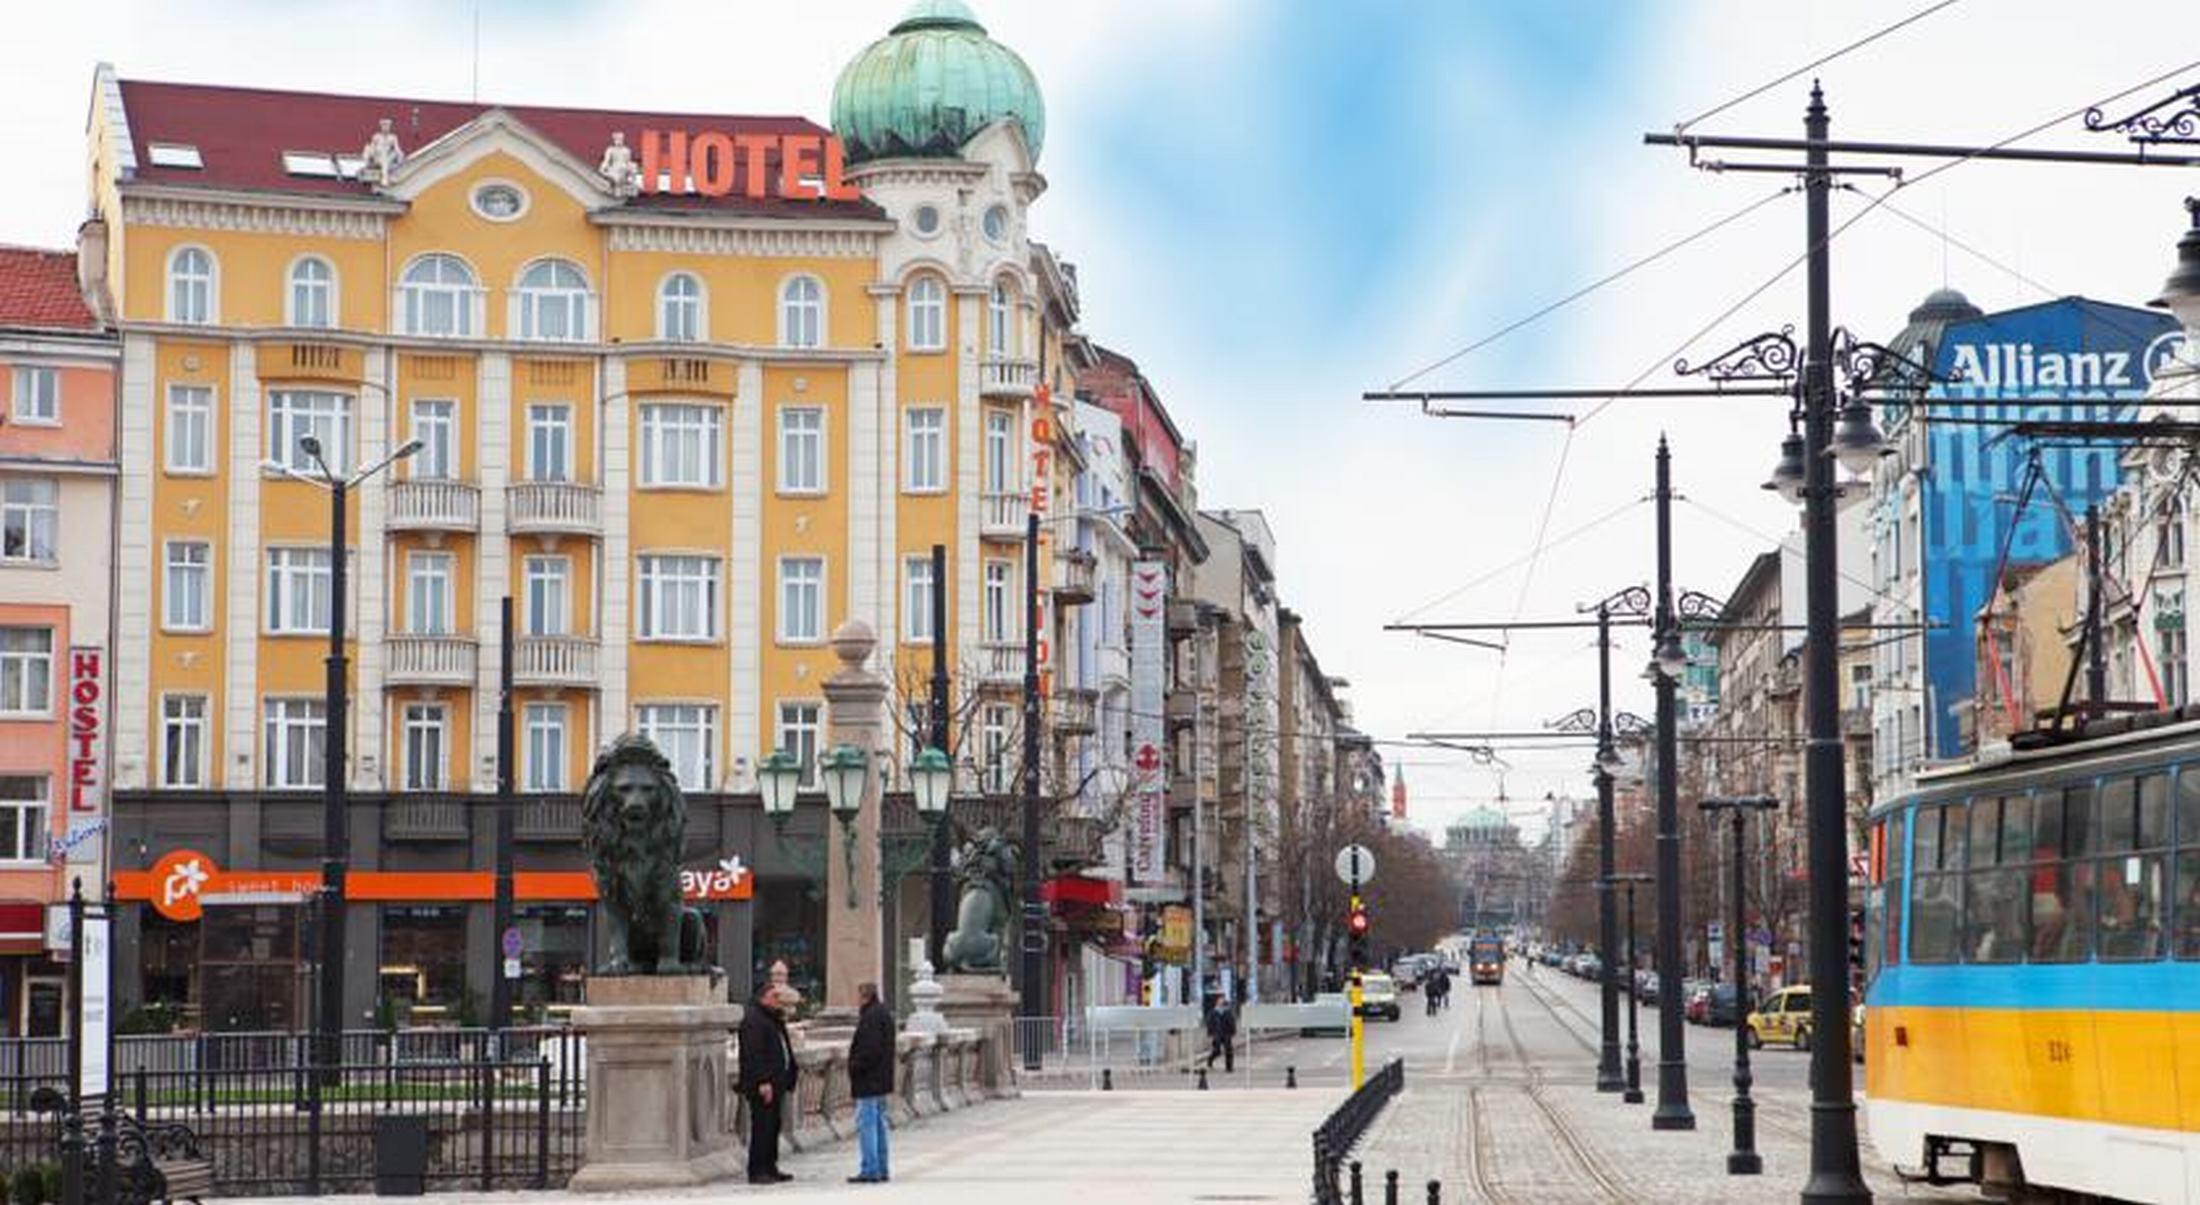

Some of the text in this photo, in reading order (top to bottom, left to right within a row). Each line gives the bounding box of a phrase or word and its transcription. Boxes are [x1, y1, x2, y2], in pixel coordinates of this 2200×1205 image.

[642, 130, 859, 200] HOTEL
[1949, 343, 2131, 387] Allianz
[73, 653, 99, 812] HOSTEL
